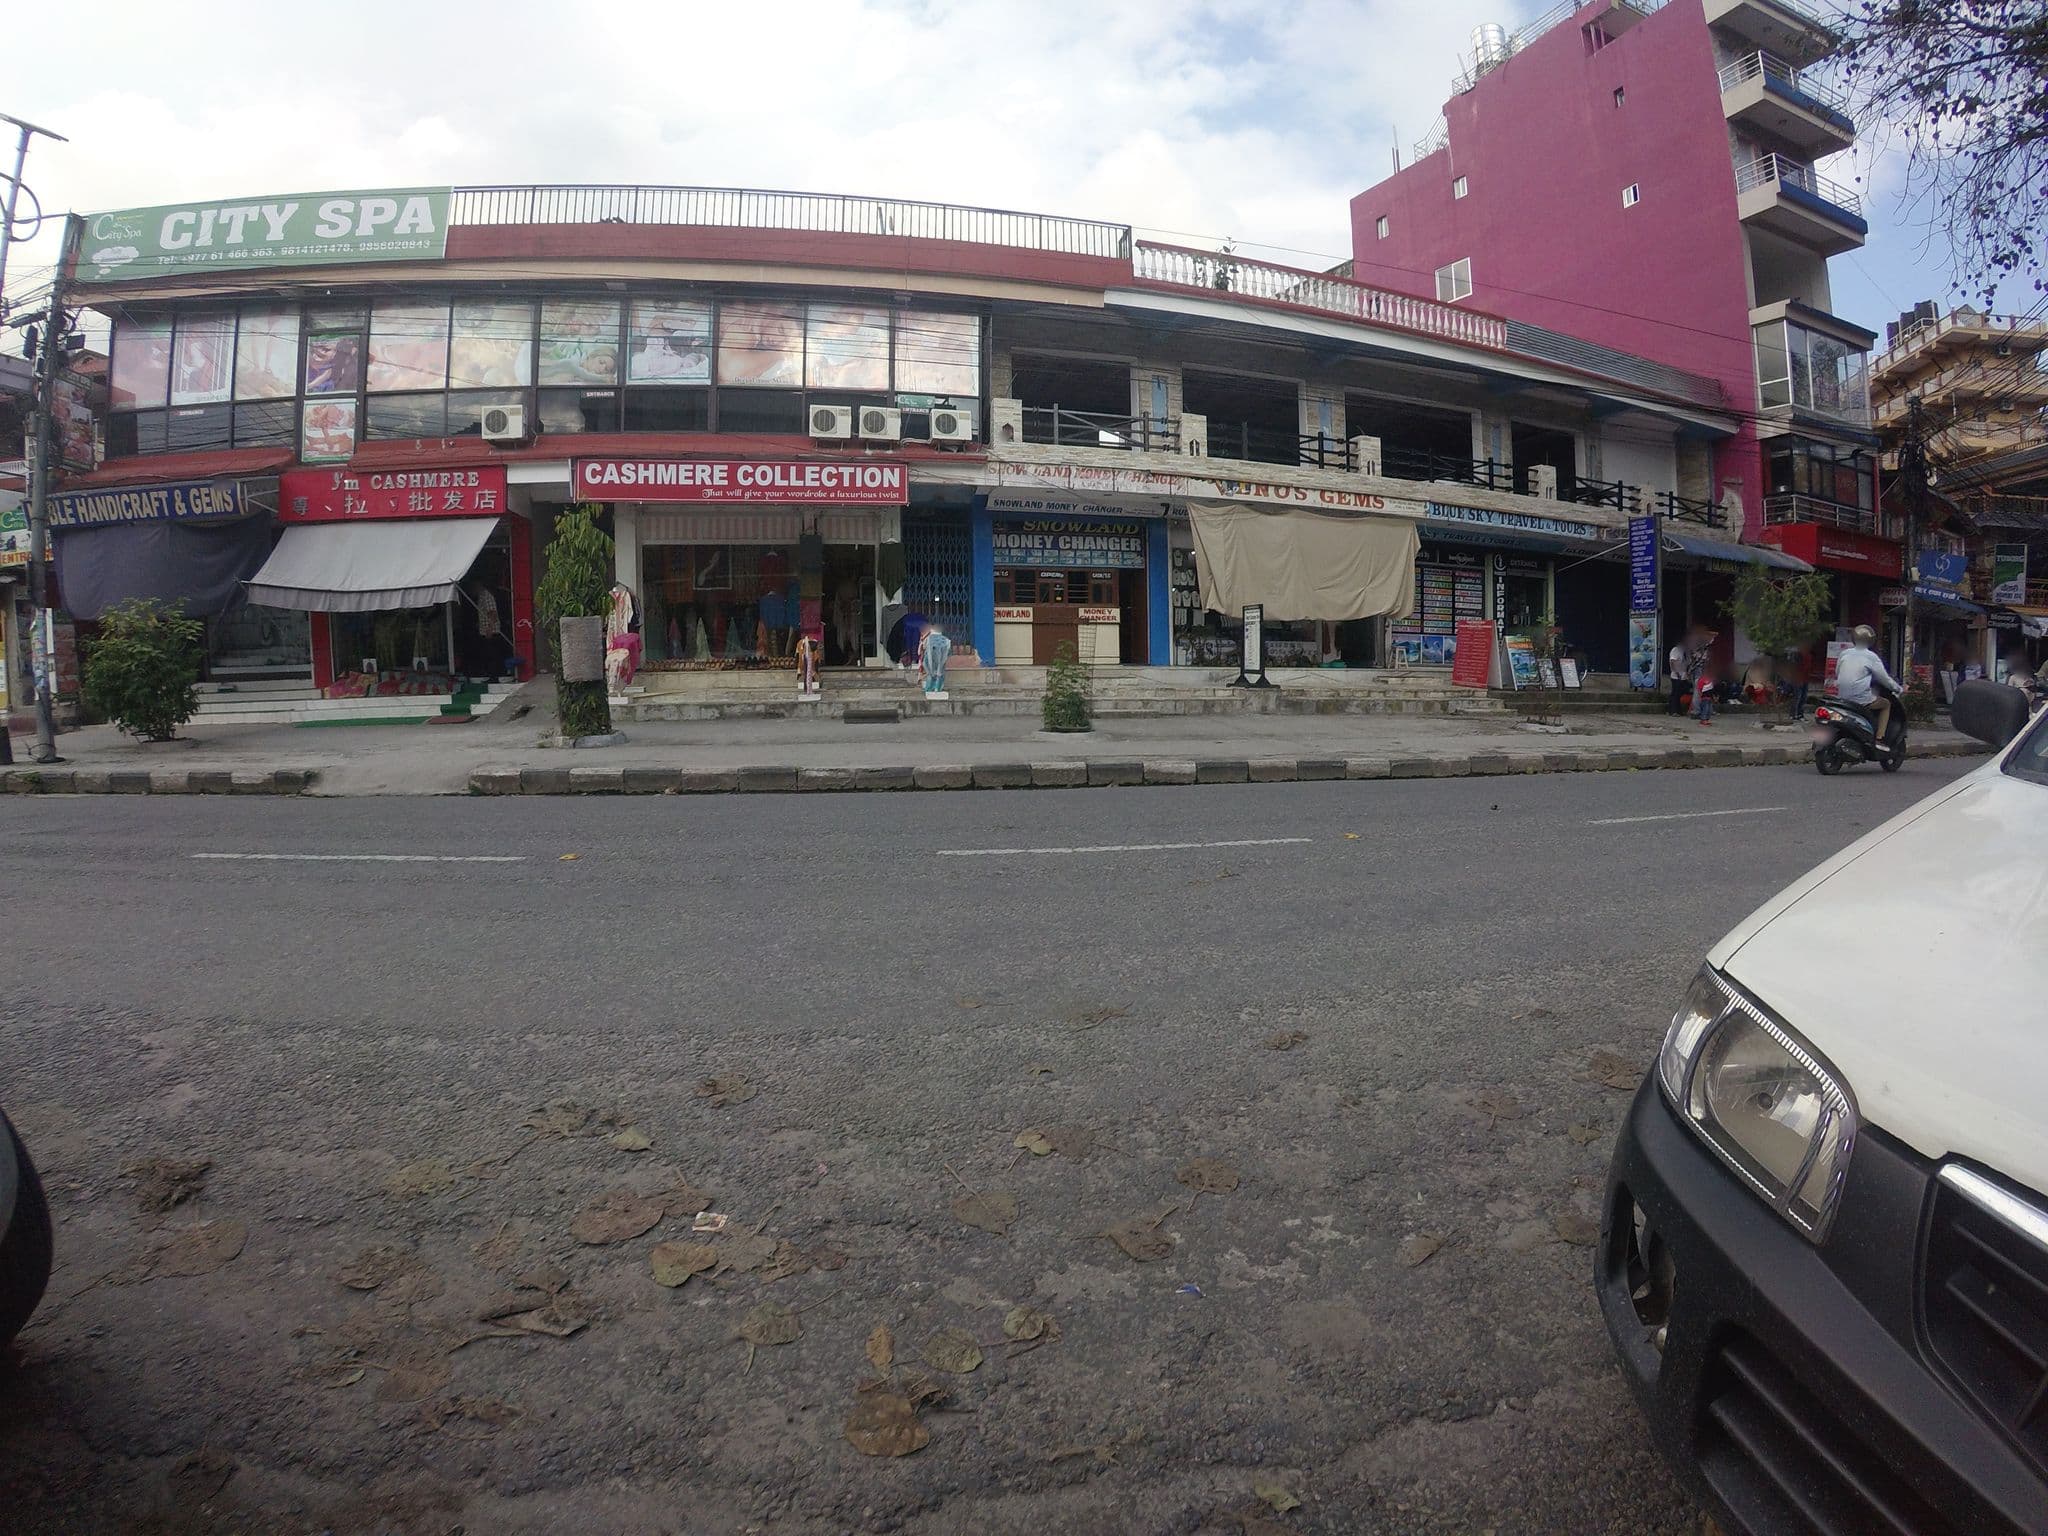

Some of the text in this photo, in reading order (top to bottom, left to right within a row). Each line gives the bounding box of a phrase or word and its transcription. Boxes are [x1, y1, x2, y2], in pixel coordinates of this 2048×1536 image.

[160, 196, 435, 250] CITY SPA
[371, 471, 480, 490] CASHMERE
[585, 463, 900, 488] CASHMERE COLLECTION
[702, 489, 723, 499] That
[726, 489, 742, 498] will
[744, 489, 762, 499] give
[764, 491, 785, 500] your
[1319, 489, 1386, 510] GEMS
[75, 489, 169, 524] HANDICRAFT
[174, 489, 187, 513] &
[189, 487, 234, 515] GEMS
[993, 499, 1123, 514] SNOWLAND MONEY CHANGER
[1023, 520, 1139, 535] SNOWLAND
[1432, 503, 1464, 520] BLUE
[1467, 508, 1494, 524] SKY
[1499, 512, 1544, 531] TRAVEL
[1552, 521, 1587, 536] TOURS
[992, 534, 1142, 551] MONEY CHANGER
